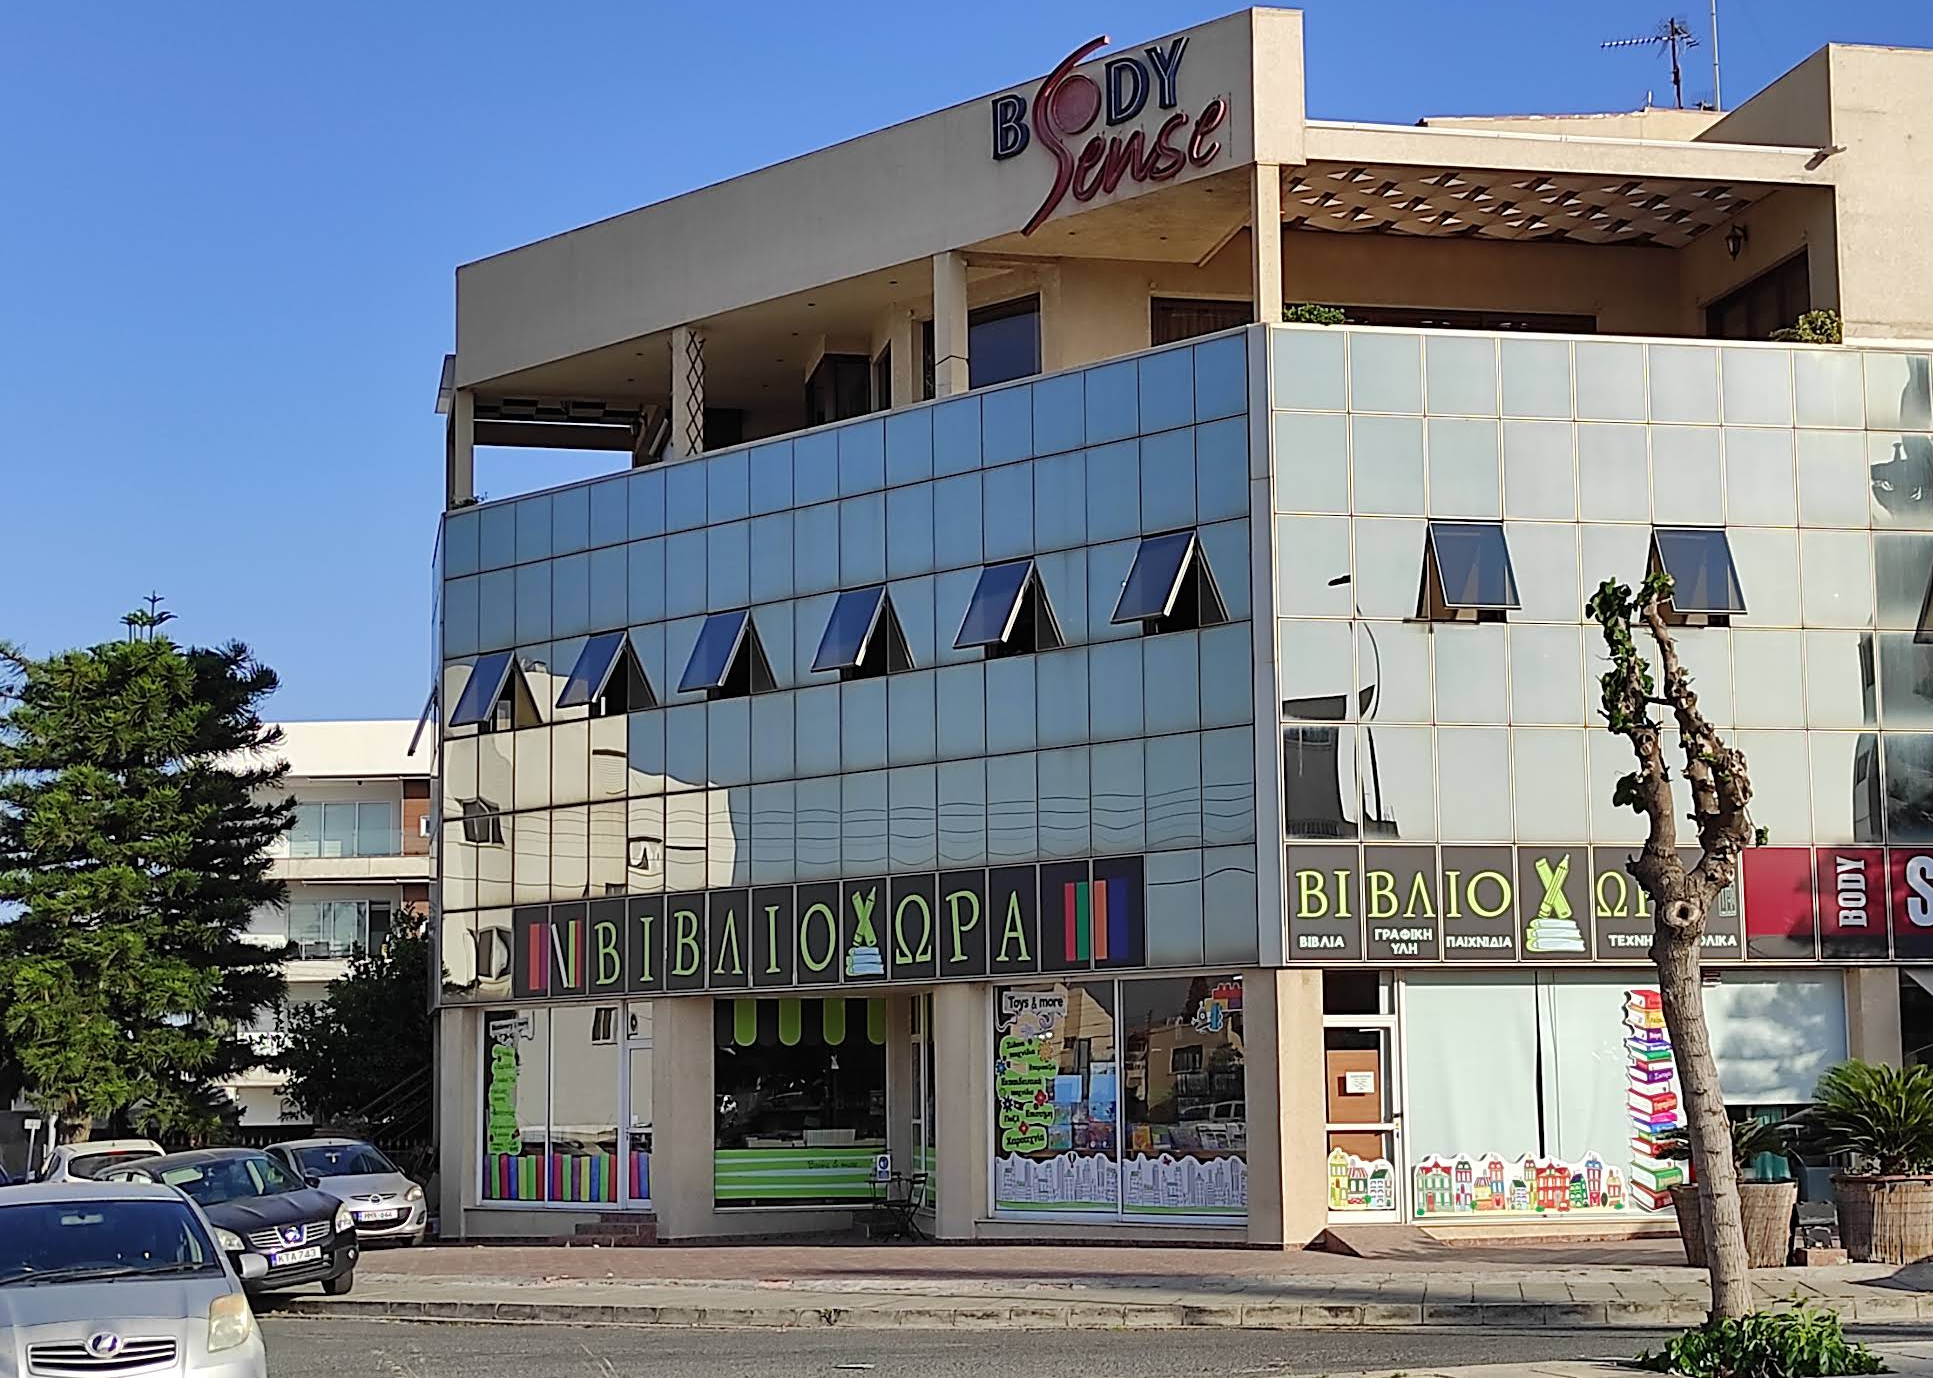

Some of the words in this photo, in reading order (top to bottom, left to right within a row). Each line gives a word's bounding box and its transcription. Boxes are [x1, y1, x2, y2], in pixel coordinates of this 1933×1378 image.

[992, 36, 1190, 161] BODY
[1021, 35, 1226, 237] Sense
[1836, 856, 1868, 928] BODY
[1299, 936, 1345, 948] ΒΙΒΛΙΑ
[1374, 928, 1433, 941] ΓΡΑΦΙΚΗ
[1446, 936, 1513, 948] ΠΑΙΧΝΙΔΙΑ
[1391, 943, 1418, 955] ΥΛΗ
[1008, 995, 1029, 1011] Toys
[1039, 998, 1063, 1008] more
[278, 1252, 297, 1263] KTA
[298, 1248, 317, 1259] 743
